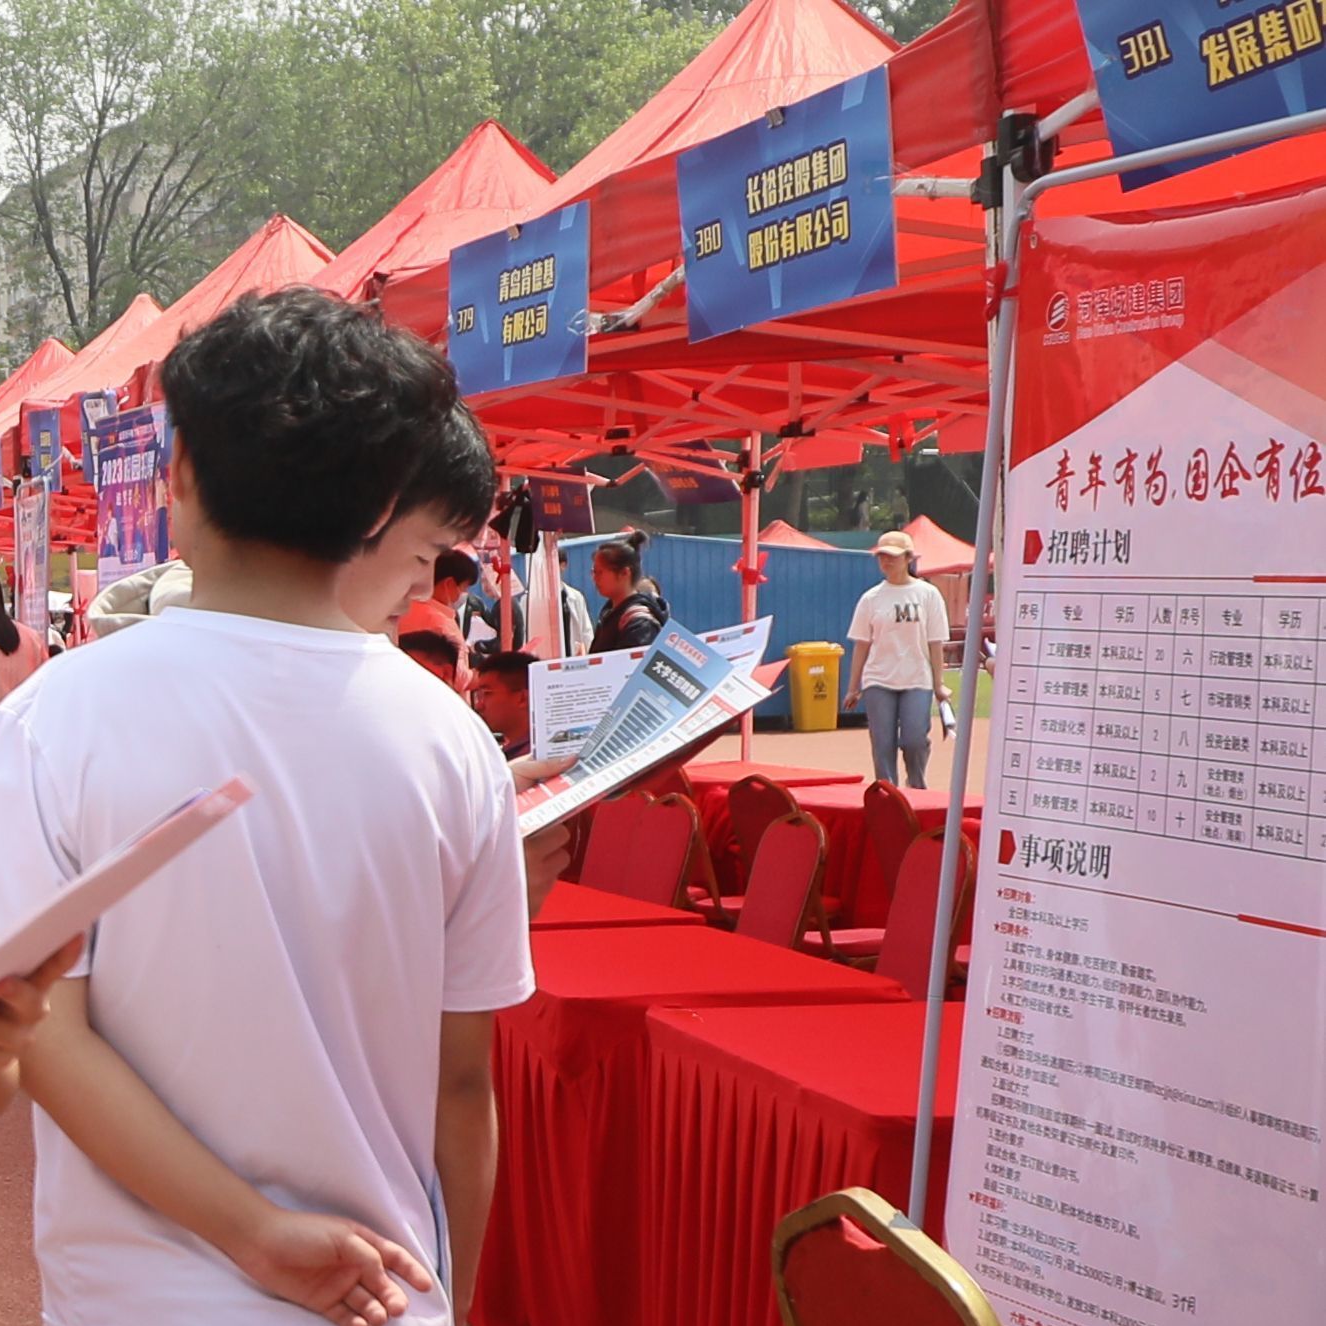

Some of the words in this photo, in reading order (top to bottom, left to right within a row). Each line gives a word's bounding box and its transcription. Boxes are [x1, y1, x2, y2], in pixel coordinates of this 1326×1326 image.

[1119, 22, 1171, 77] 381
[1201, 0, 1326, 88] 发展集团
[746, 140, 848, 216] 长裕控股集团
[695, 220, 722, 259] 380
[748, 198, 850, 271] 股份有限公司
[499, 256, 555, 303] 青岛肯德基
[456, 306, 475, 335] 379
[502, 303, 549, 345] 有限公司
[1047, 528, 1132, 566] 招聘计划
[1018, 603, 1039, 620] 序号
[1062, 605, 1083, 621] 专业
[1115, 606, 1135, 623] 学历
[1152, 607, 1172, 624] 人数
[1180, 608, 1200, 626] 序号
[1222, 609, 1243, 627] 专业
[1278, 610, 1302, 629] 学历
[1182, 649, 1193, 665] 六
[1263, 654, 1313, 671] 本科及以上
[1017, 679, 1027, 693] 二
[1180, 689, 1192, 707] 七
[1261, 697, 1311, 714] 本科及以上
[1014, 715, 1024, 731] 三
[1178, 730, 1189, 747] 八
[1260, 740, 1308, 758] 本科及以上
[1010, 753, 1021, 768] 四
[1176, 770, 1187, 788] 九
[1258, 782, 1306, 802] 本科及以上
[1174, 811, 1186, 829] 十
[1255, 825, 1304, 845] 本科及以上
[1020, 833, 1112, 880] 事项说明
